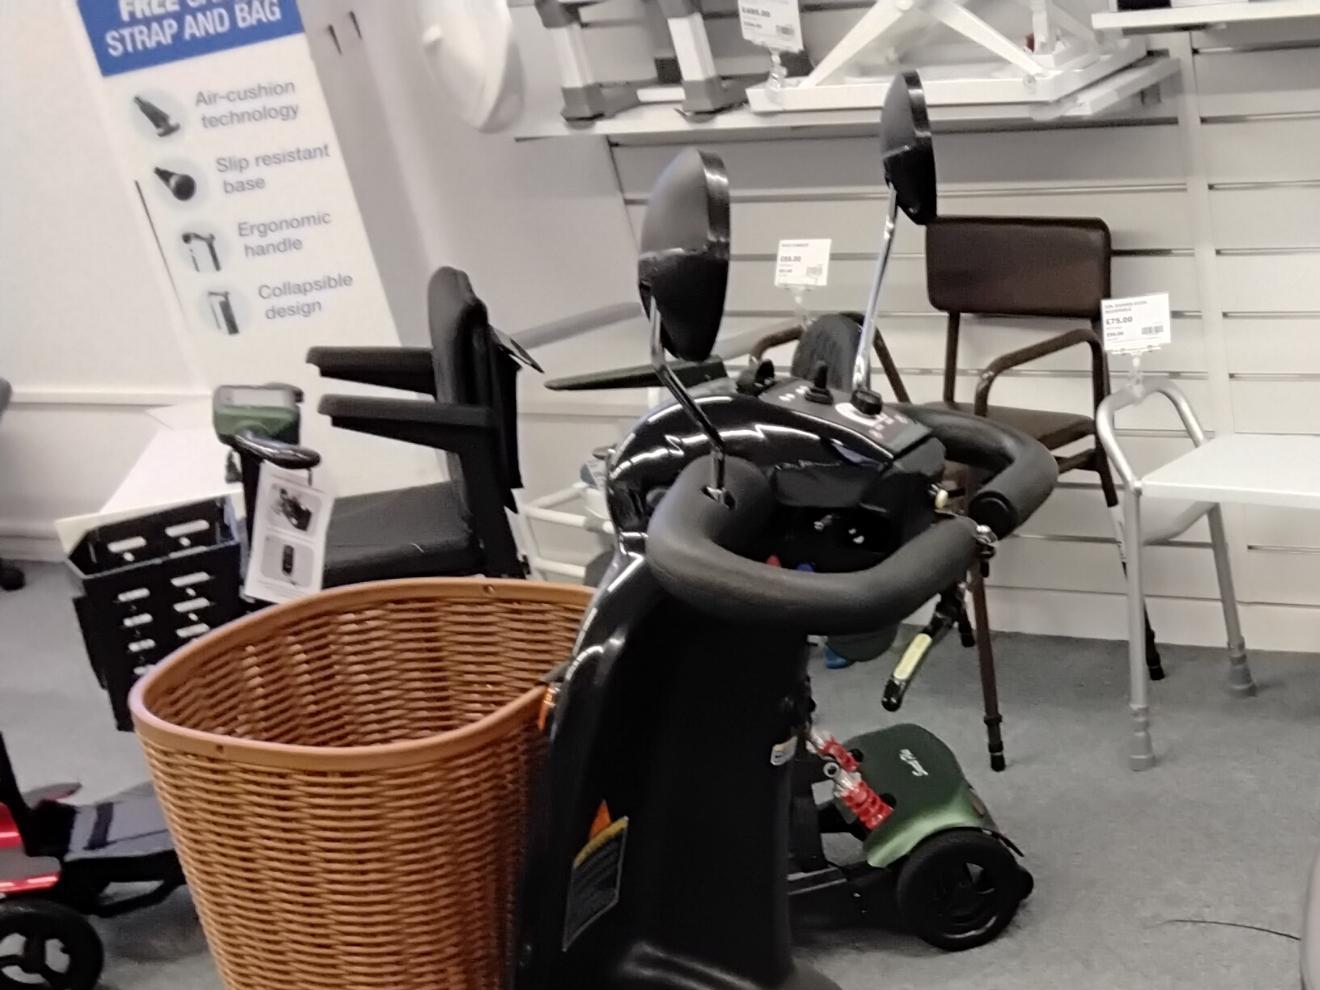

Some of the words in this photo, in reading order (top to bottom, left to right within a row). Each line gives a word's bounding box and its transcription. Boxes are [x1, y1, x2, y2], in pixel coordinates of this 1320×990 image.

[119, 0, 180, 22] FREE
[105, 18, 178, 57] STRAP
[184, 7, 230, 40] AND
[234, 0, 282, 28] BAG
[194, 81, 297, 107] Air-cushion
[201, 103, 300, 129] technology
[215, 156, 250, 174] Slip
[254, 143, 331, 168] resistant
[223, 176, 266, 195] base
[237, 212, 332, 239] Ergonomic
[244, 237, 303, 258] handle
[258, 273, 354, 300] Collapsible
[264, 300, 322, 320] design
[1105, 316, 1133, 325] £75.00
